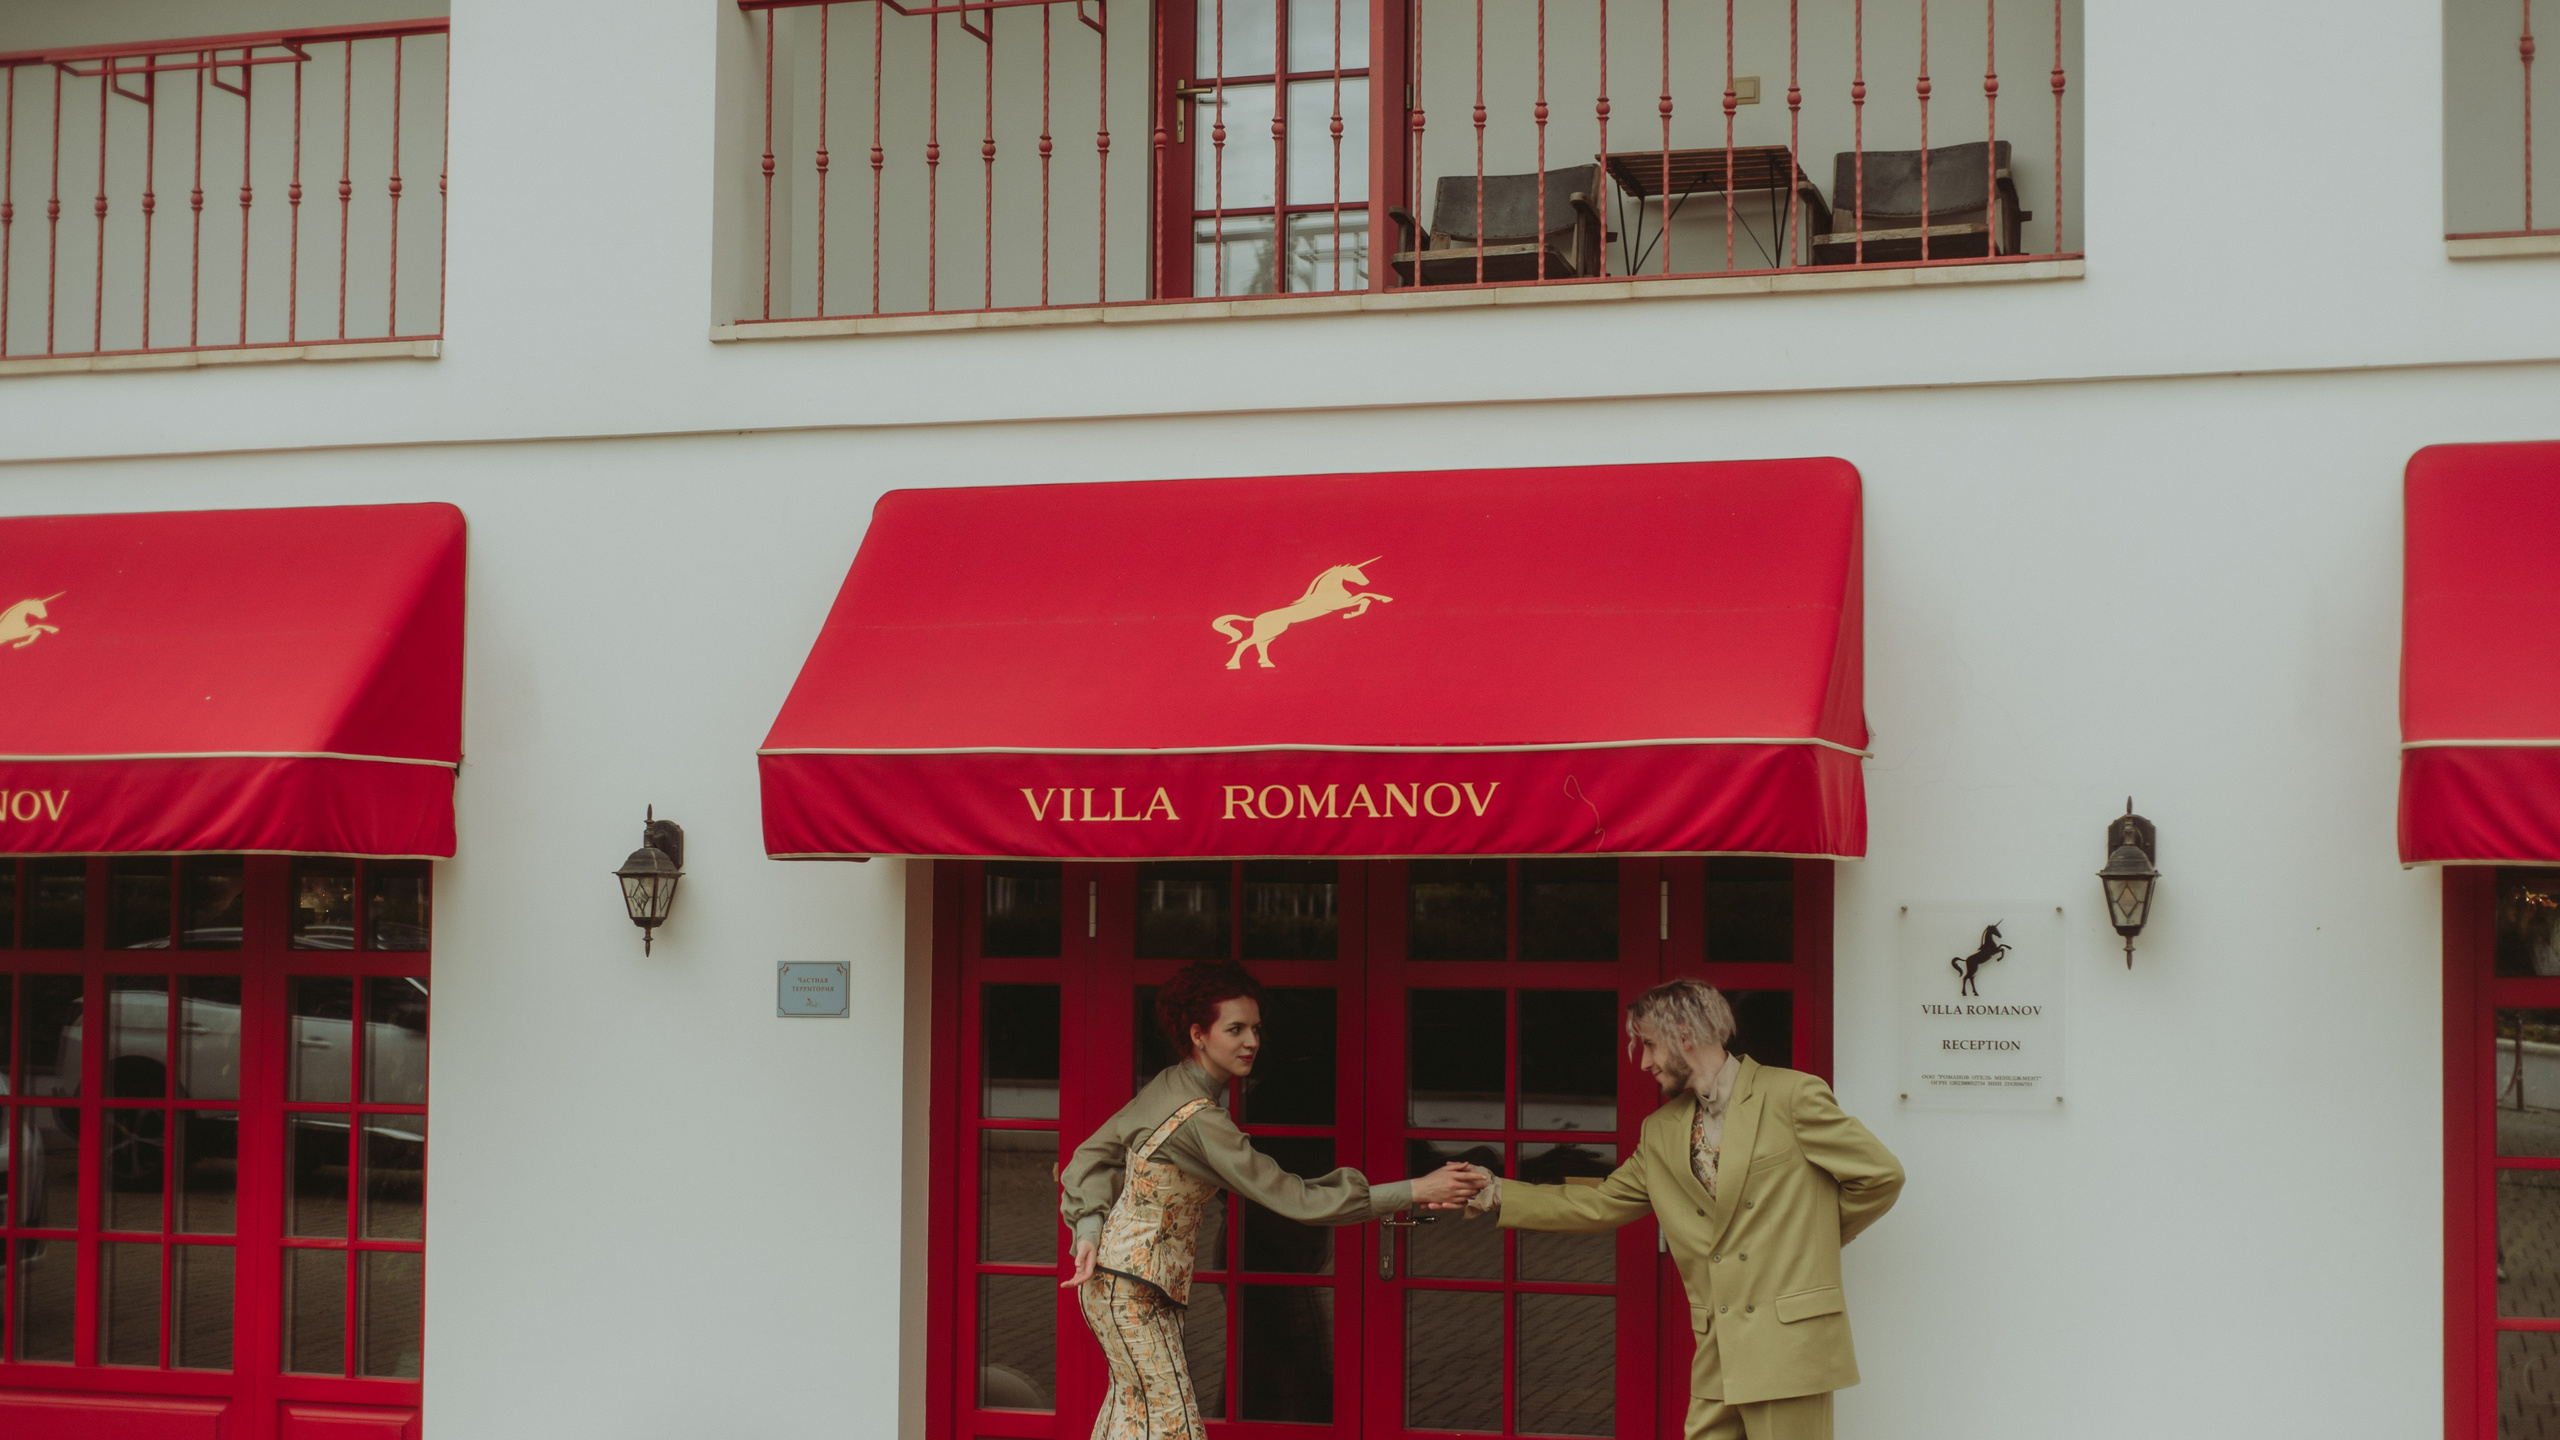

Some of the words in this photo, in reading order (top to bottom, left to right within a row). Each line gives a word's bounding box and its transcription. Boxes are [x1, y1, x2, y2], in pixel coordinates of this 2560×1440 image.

[0, 790, 70, 822] OV
[1020, 786, 1180, 822] VILLA
[1221, 781, 1501, 820] ROMANOV
[1921, 1004, 1963, 1015] VILLA
[1966, 1005, 2043, 1016] ROMANOV
[1942, 1039, 2021, 1051] RECEPTION
